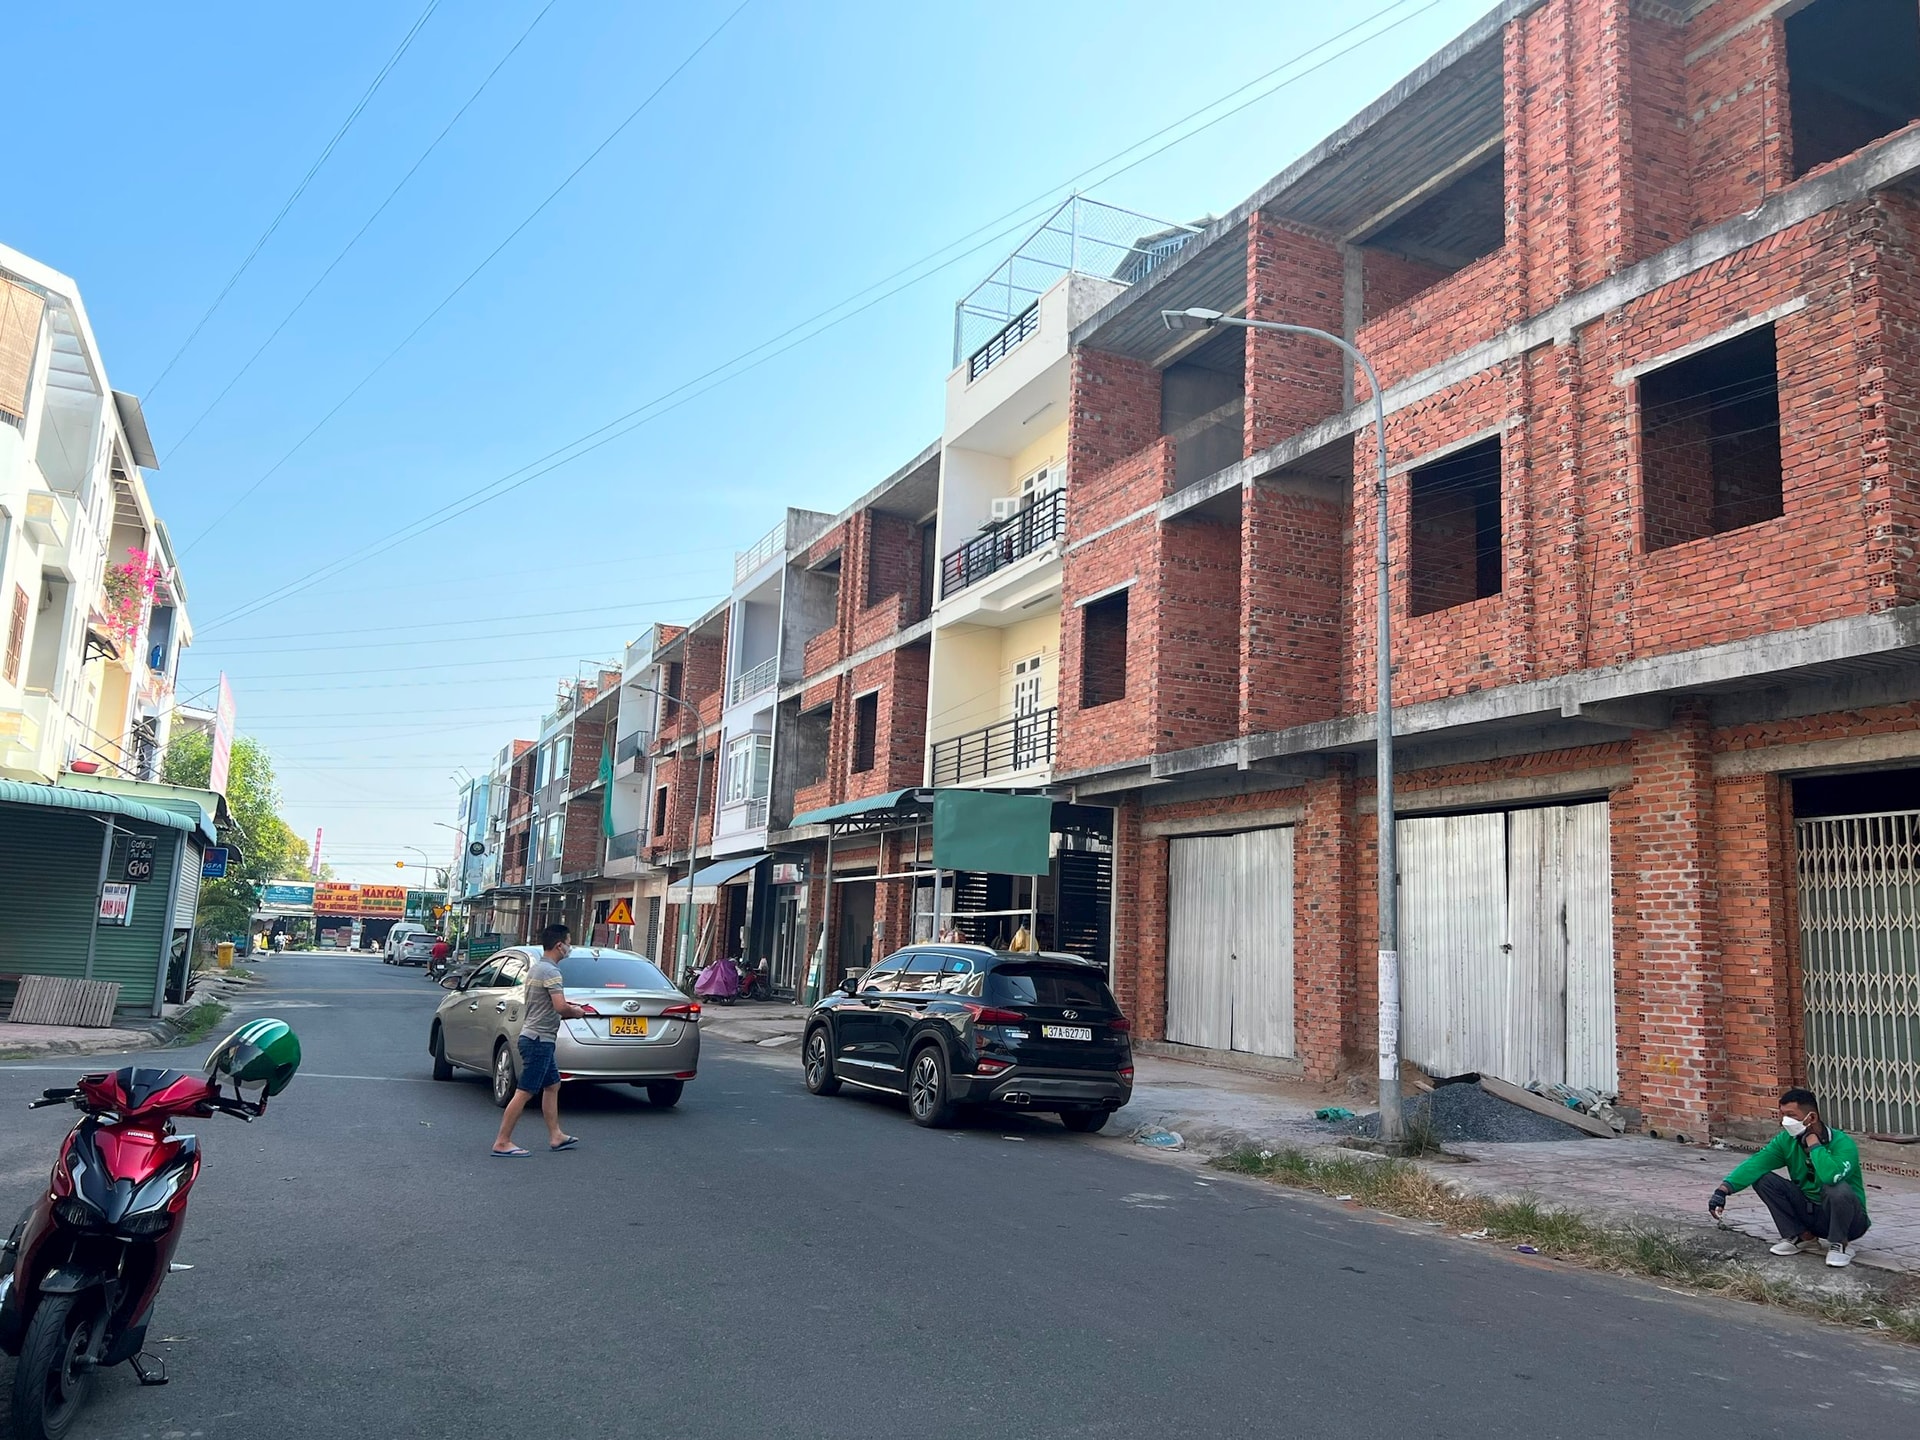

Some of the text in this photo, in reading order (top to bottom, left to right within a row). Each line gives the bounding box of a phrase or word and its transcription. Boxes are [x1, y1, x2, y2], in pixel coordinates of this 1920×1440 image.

[622, 1017, 637, 1026] 70A
[615, 1026, 643, 1035] 245.54
[127, 1131, 154, 1140] HONDA
